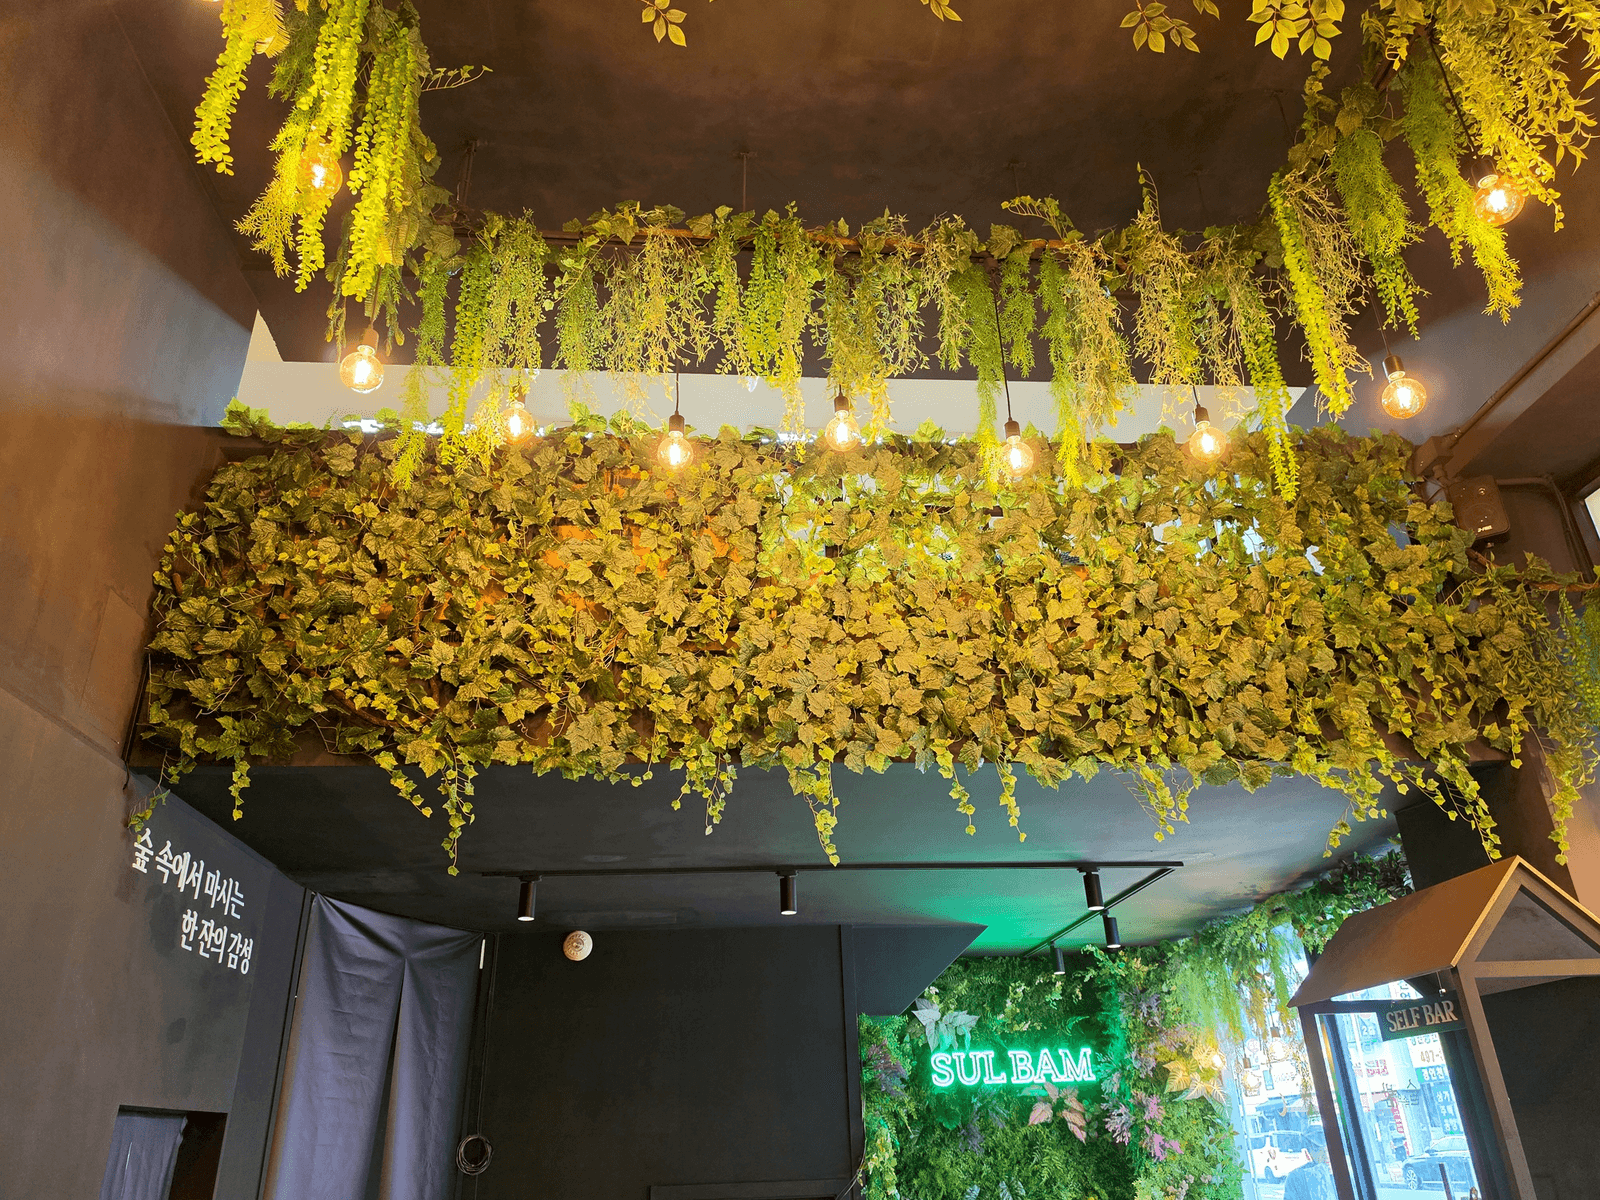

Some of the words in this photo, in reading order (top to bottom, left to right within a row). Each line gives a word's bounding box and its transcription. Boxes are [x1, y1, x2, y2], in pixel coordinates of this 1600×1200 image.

[132, 828, 153, 873] 숲
[155, 840, 205, 900] 속에서
[204, 870, 245, 919] 마시는
[181, 909, 198, 951] 한
[198, 919, 228, 963] 잔의
[227, 933, 253, 974] 감성
[1386, 1007, 1420, 1032] SELF
[1421, 1000, 1458, 1025] BAR
